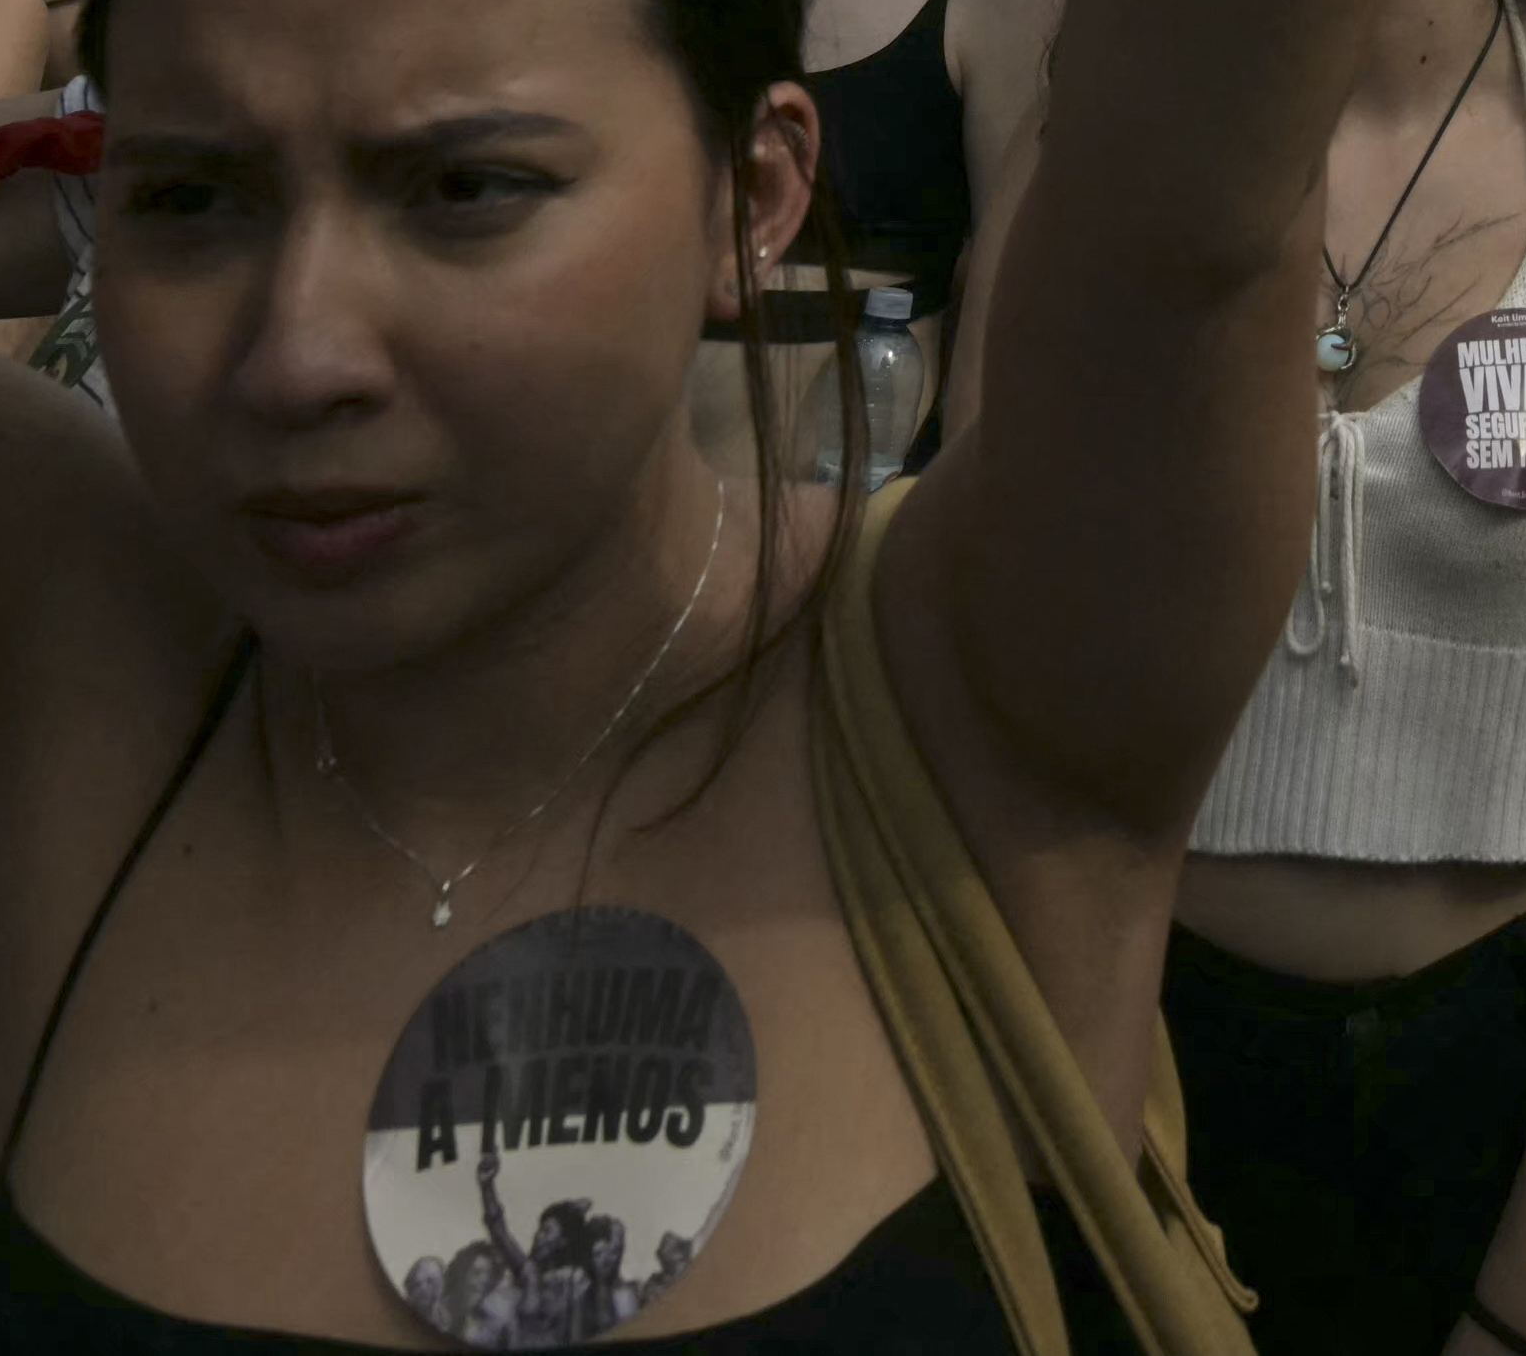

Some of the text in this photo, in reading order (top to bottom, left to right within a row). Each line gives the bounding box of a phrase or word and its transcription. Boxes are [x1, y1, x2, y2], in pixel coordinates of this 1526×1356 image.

[1465, 440, 1514, 470] SEM
[430, 967, 727, 1073] NENHUMA
[416, 1077, 458, 1172] A
[481, 1054, 716, 1154] MENOS
